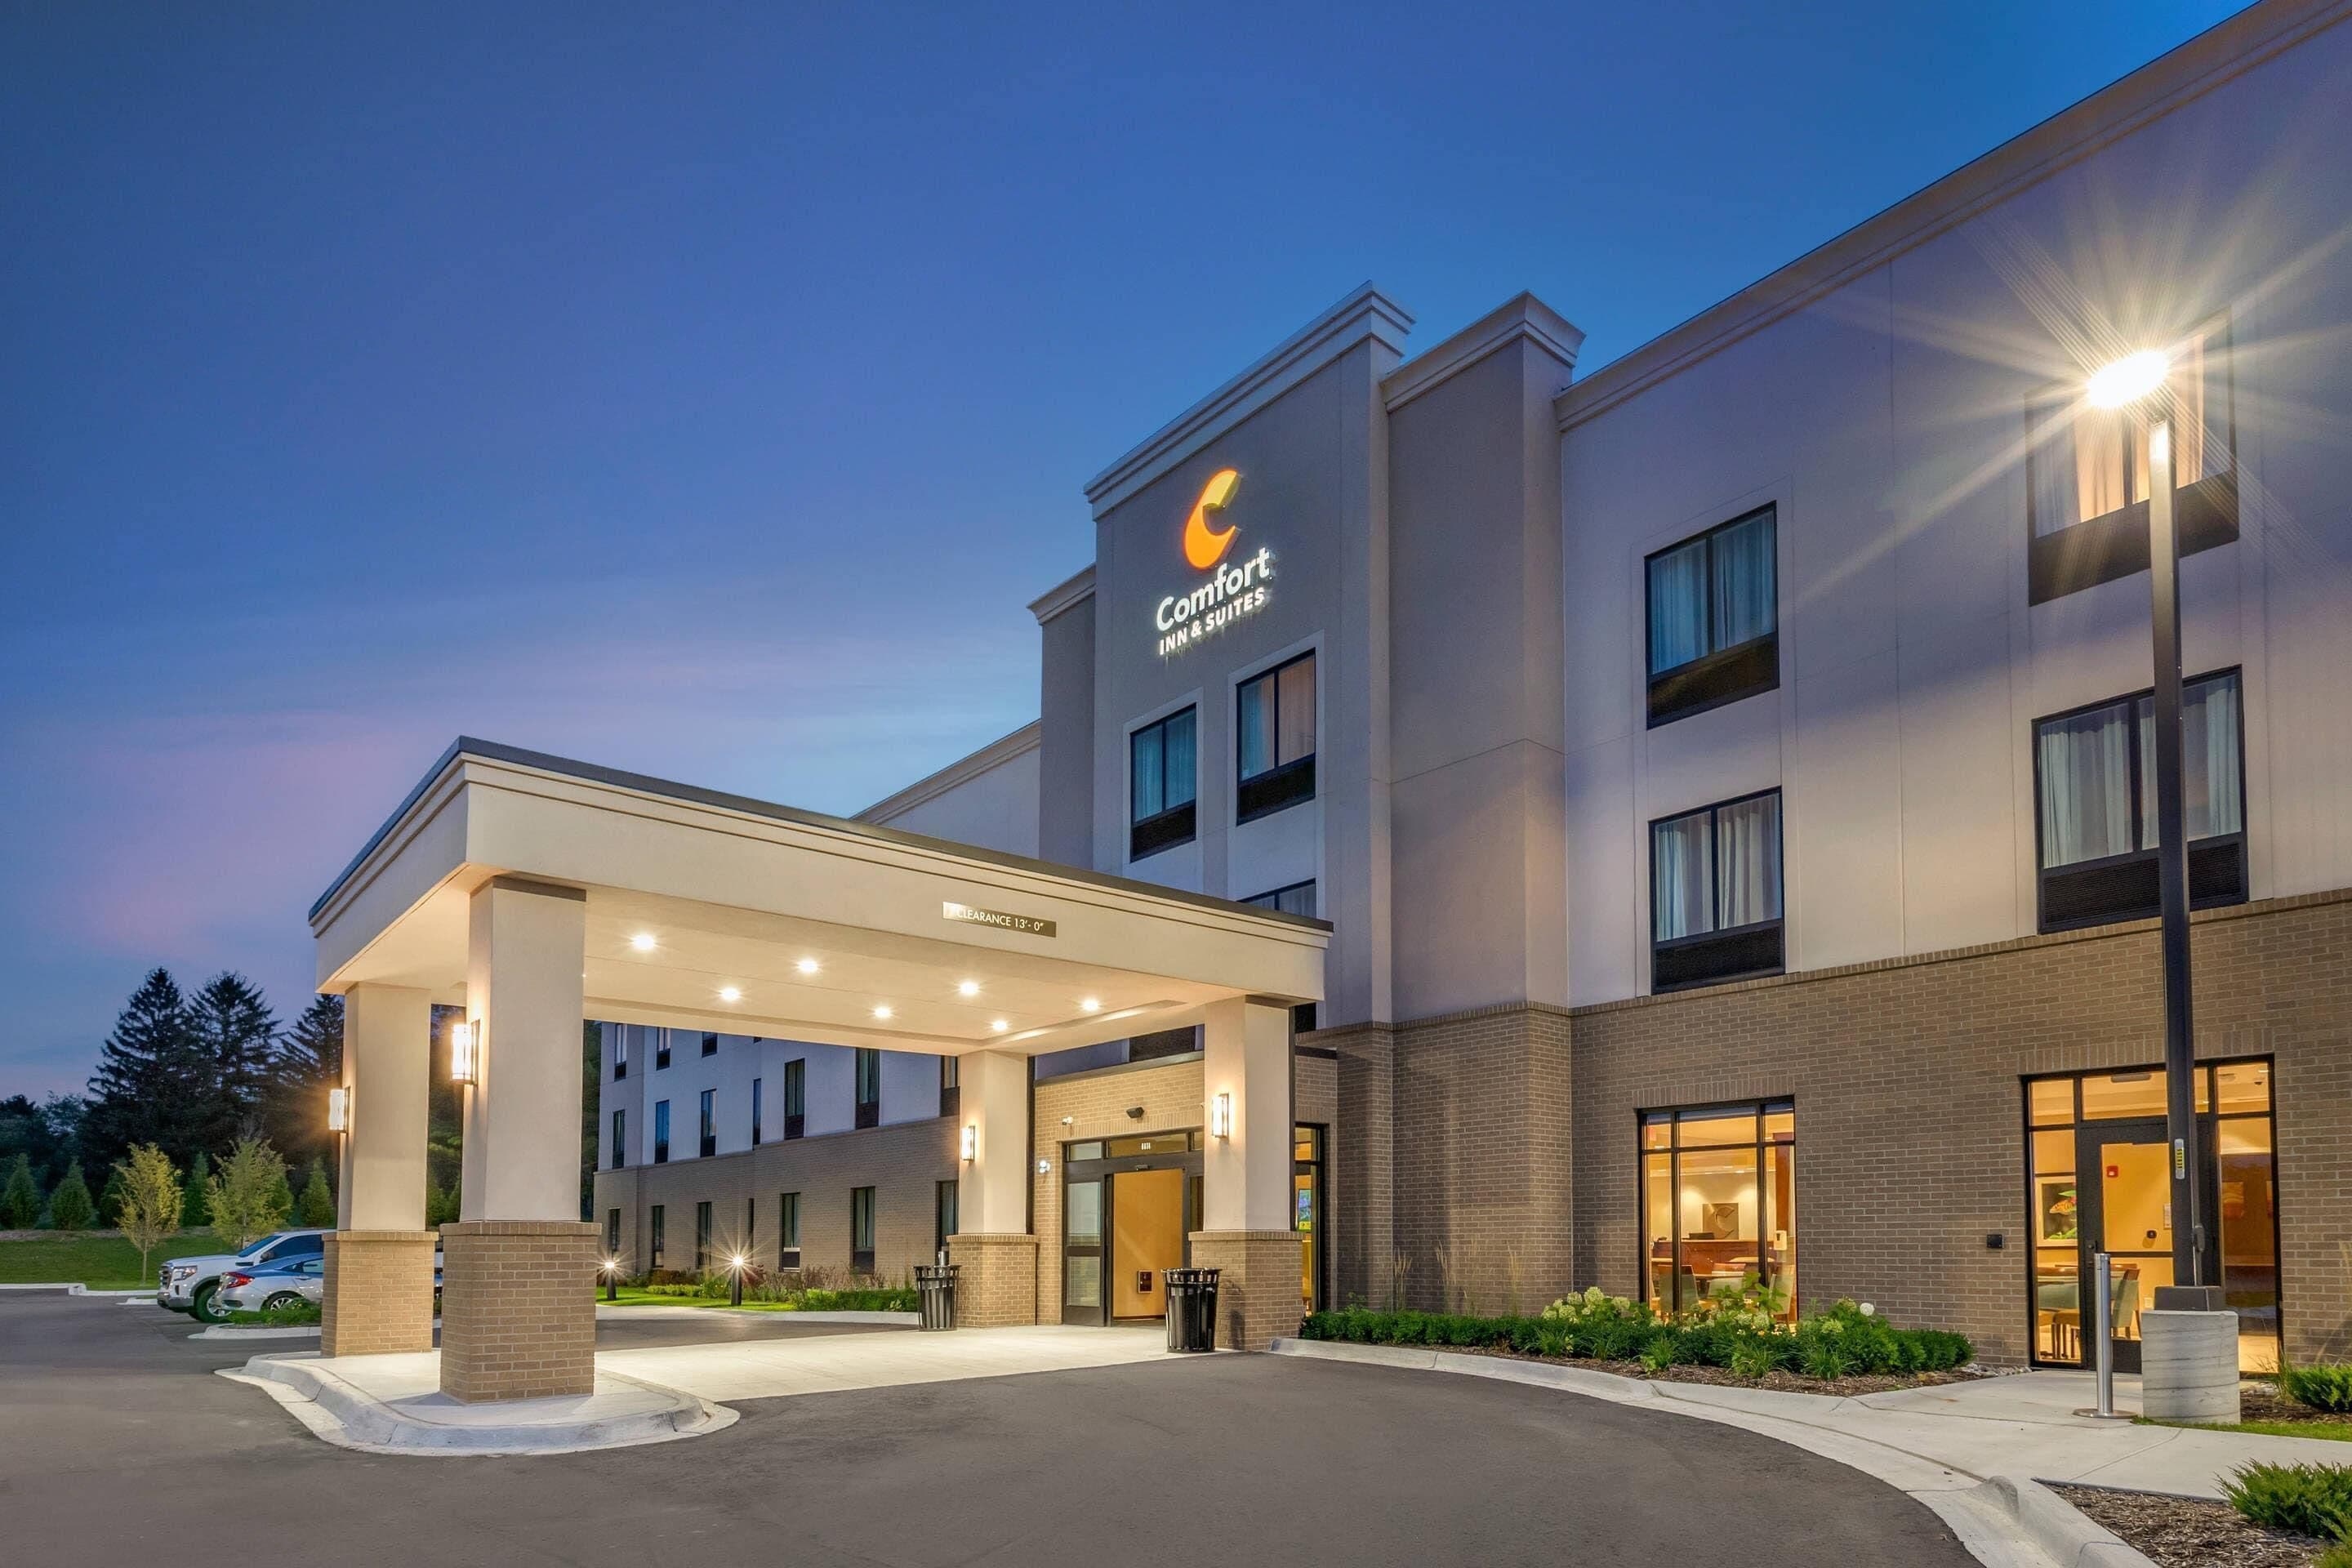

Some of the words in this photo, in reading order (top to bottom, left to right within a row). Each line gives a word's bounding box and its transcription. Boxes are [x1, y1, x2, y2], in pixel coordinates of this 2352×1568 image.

[1156, 547, 1272, 631] Comfort
[1160, 627, 1187, 656] INN
[1191, 620, 1202, 638] &
[1205, 587, 1265, 631] SUITES
